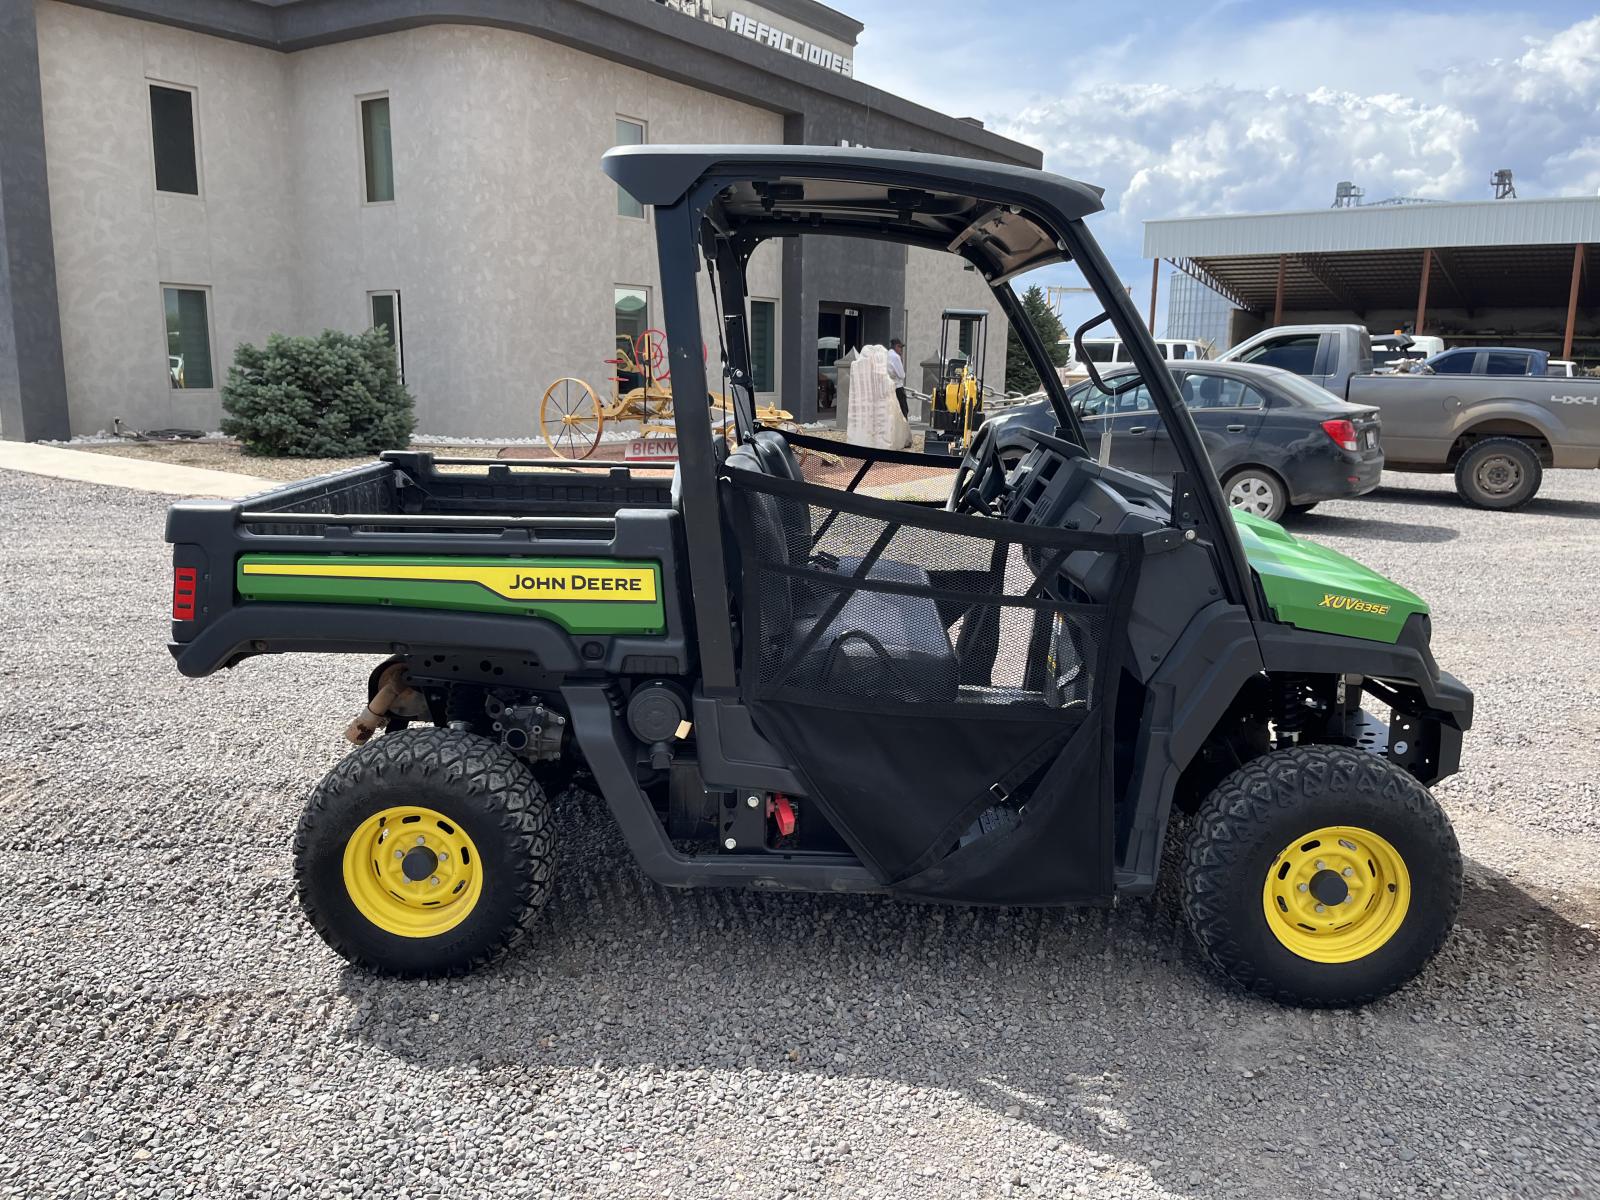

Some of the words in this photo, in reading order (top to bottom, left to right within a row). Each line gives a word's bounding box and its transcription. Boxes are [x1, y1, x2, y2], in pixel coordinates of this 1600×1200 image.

[729, 10, 853, 77] REFACCIONES
[509, 574, 566, 590] JOHN
[571, 575, 642, 591] DEERE
[1319, 594, 1389, 615] XUV835E
